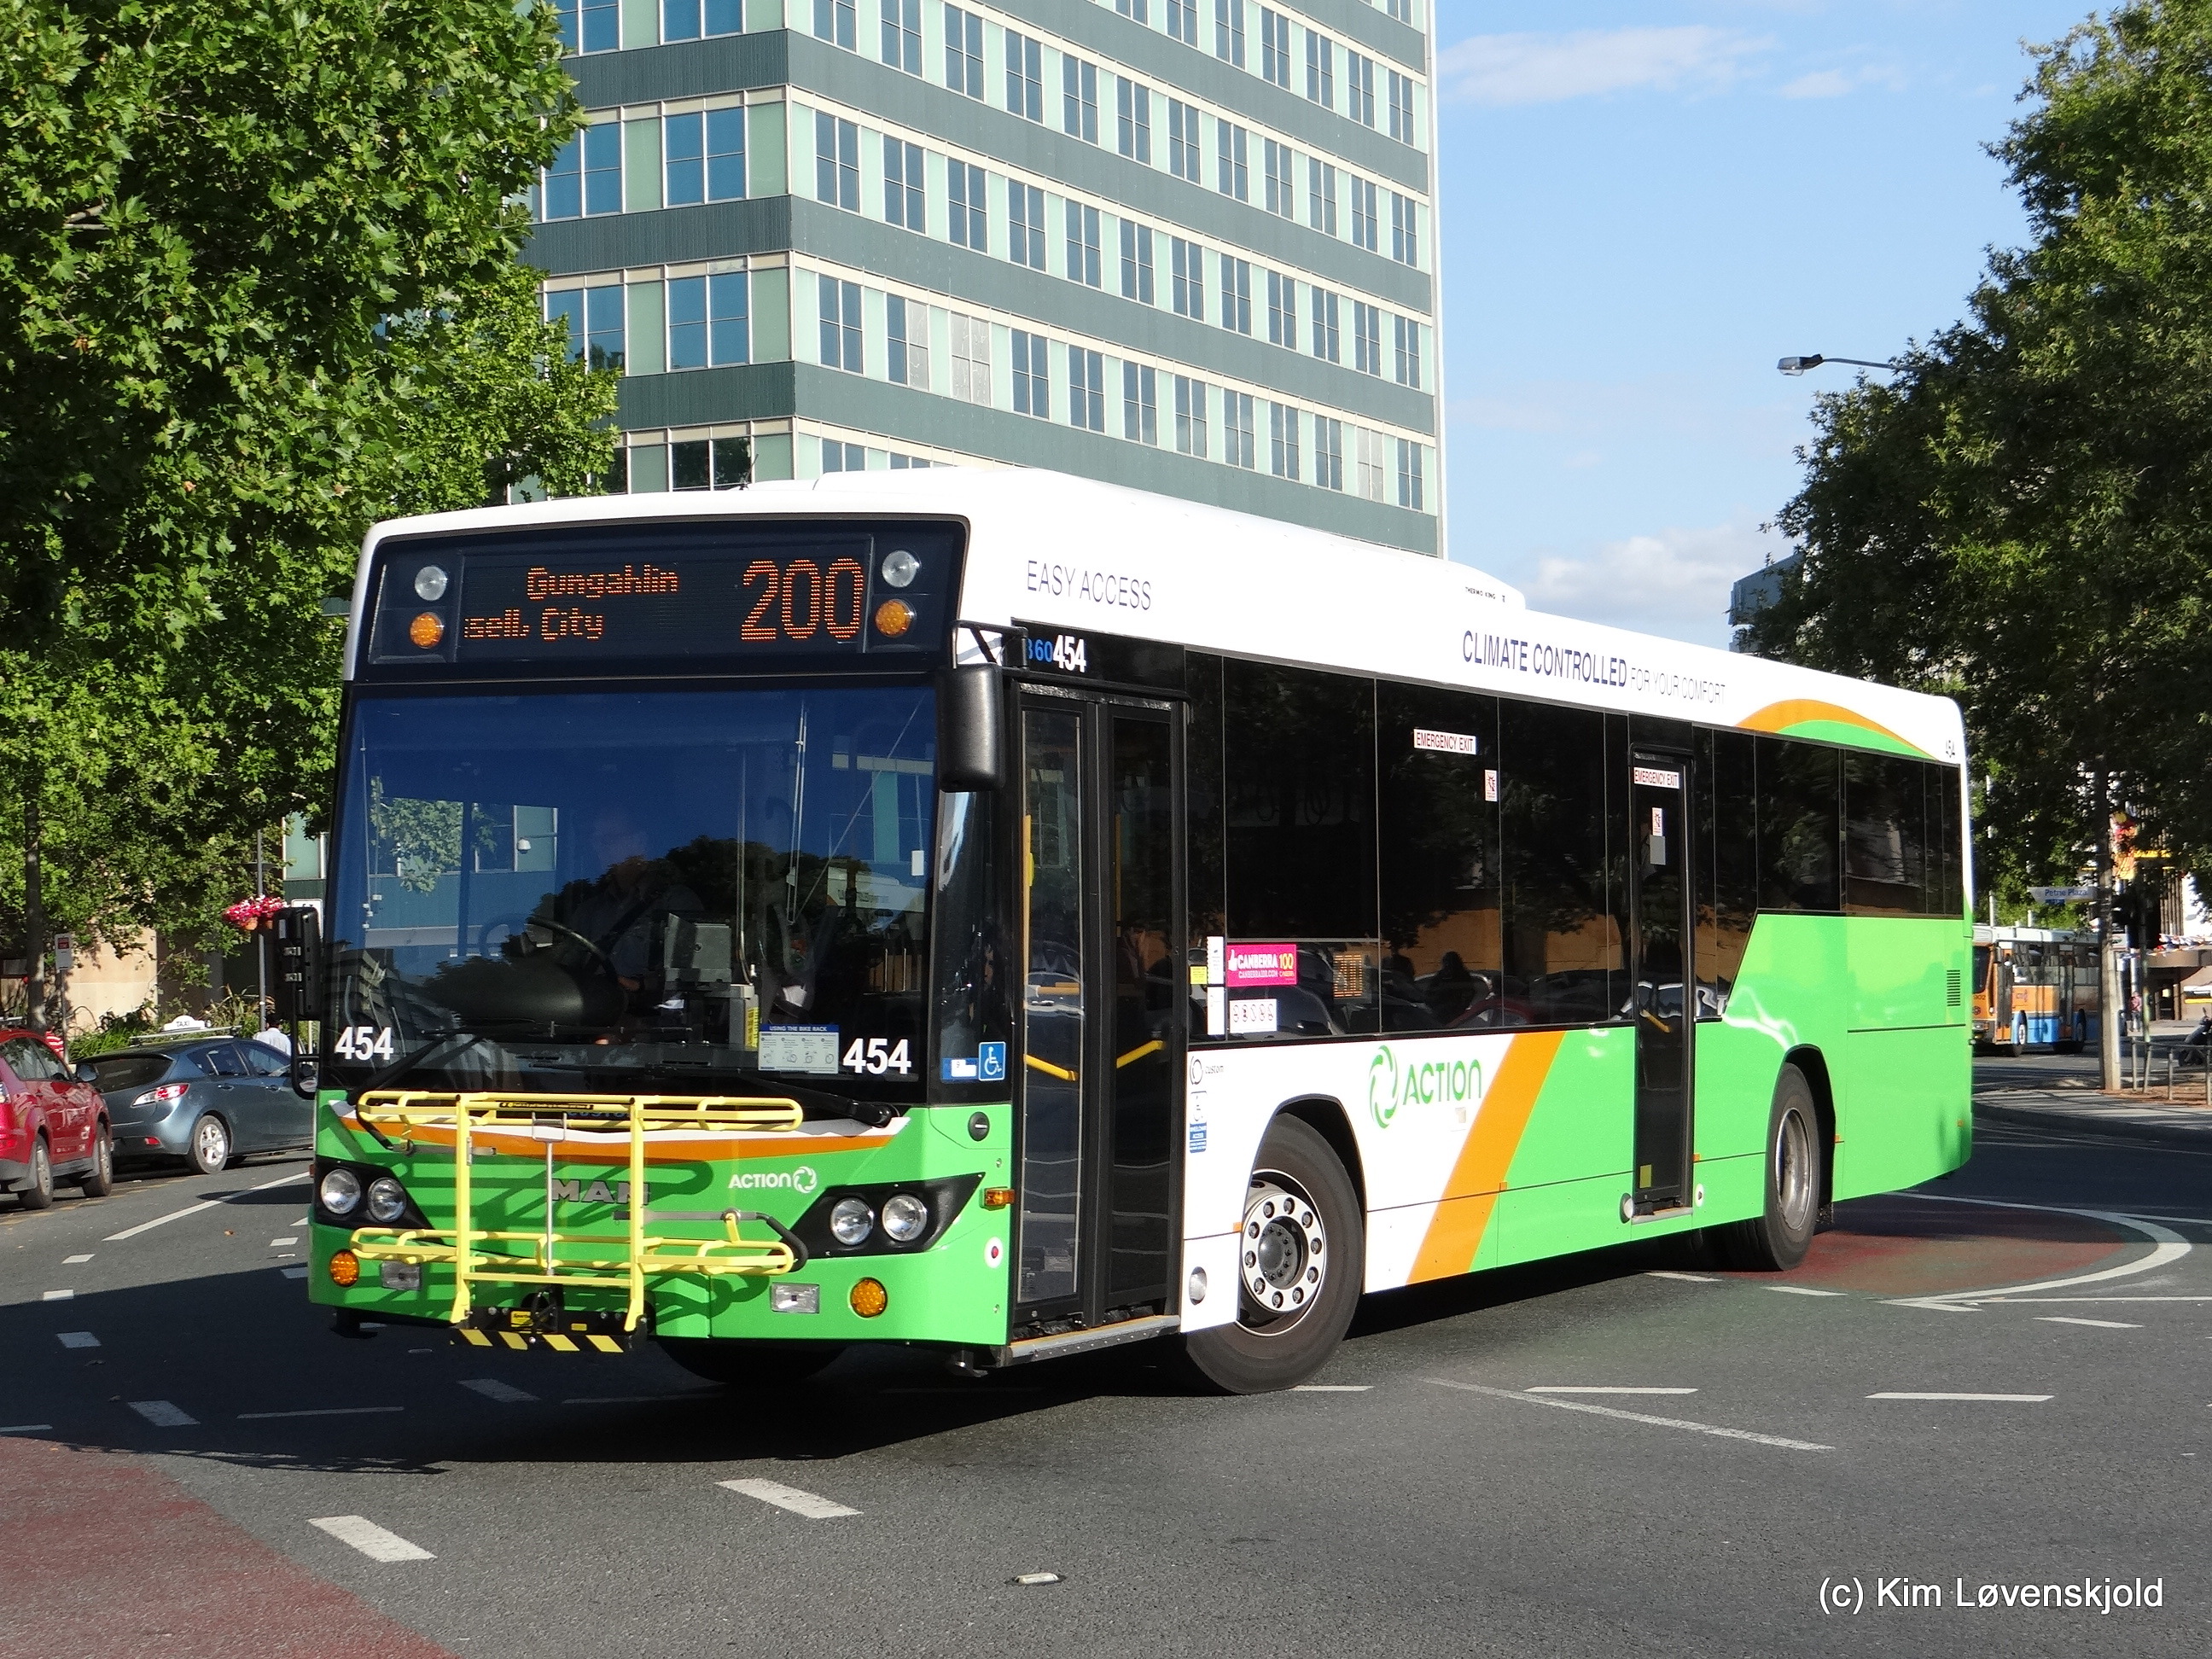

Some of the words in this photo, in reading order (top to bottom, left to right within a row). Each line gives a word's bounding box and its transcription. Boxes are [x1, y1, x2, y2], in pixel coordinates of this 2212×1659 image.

[527, 564, 678, 600] Gungahlin
[739, 557, 864, 641] 200
[1027, 559, 1076, 597] EASY
[1080, 570, 1151, 611] ACCESS
[541, 607, 602, 641] City
[1053, 634, 1087, 673] 454
[1462, 630, 1528, 672] CLIMATE
[1533, 643, 1627, 688] CONTROLLED
[1631, 667, 1650, 692] FOR
[1653, 672, 1679, 697] YOUR
[1682, 677, 1726, 704] COMFORT
[1416, 731, 1458, 750] EMERGENCY
[1459, 736, 1474, 752] EXIT
[1634, 769, 1666, 785] EMERGENCY
[1667, 773, 1678, 787] EXIT
[1237, 953, 1278, 969] CANBERRA
[1279, 952, 1294, 970] 100
[334, 1026, 394, 1061] 454
[842, 1037, 912, 1075] 454
[1402, 1058, 1482, 1106] ACTION
[727, 1171, 792, 1190] ACTION
